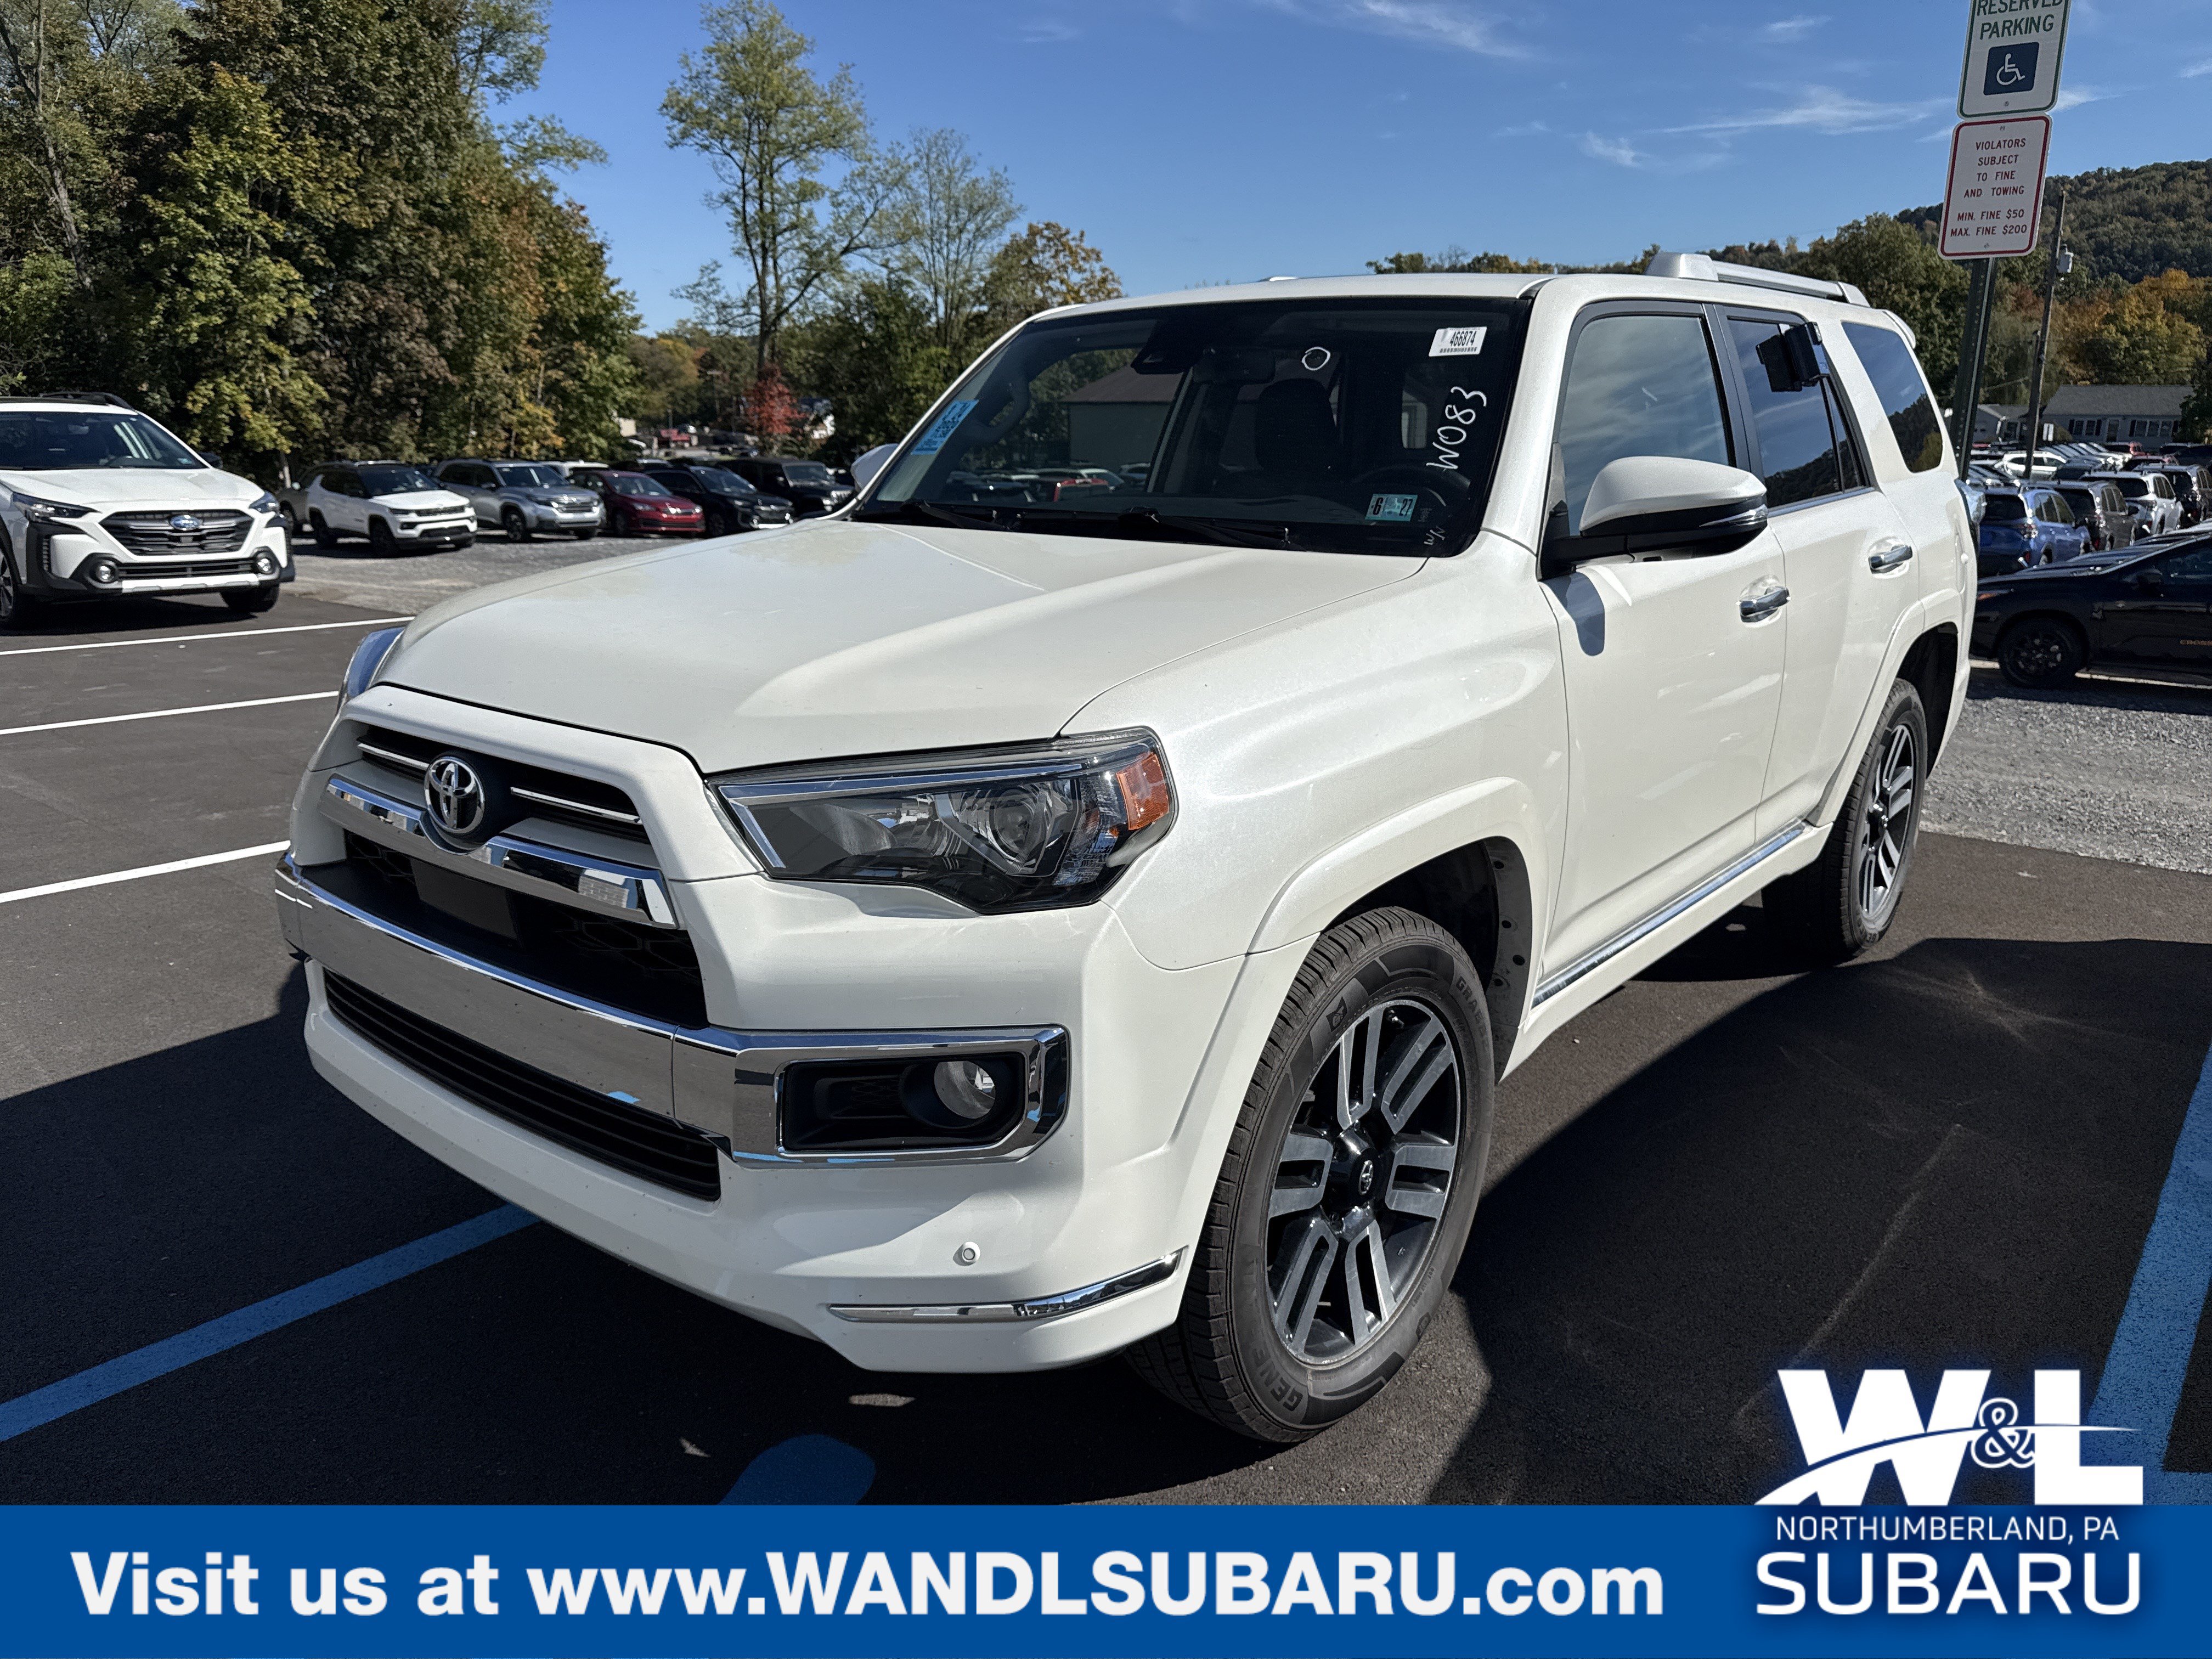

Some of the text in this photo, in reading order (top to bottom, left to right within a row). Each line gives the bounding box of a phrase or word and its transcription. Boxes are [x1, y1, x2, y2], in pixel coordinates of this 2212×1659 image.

[1979, 14, 2055, 40] PARKING
[1976, 138, 2026, 151] VIOLATORS
[1978, 155, 2019, 166] SUBJECT
[1977, 171, 2016, 182] TO FINE
[1964, 185, 2024, 198] AND TOWING
[1957, 209, 2024, 221] MIN. FINE $50
[1950, 224, 2027, 237] MAX. FINE $200
[1449, 330, 1477, 347] 466874
[1373, 497, 1413, 516] 6 27
